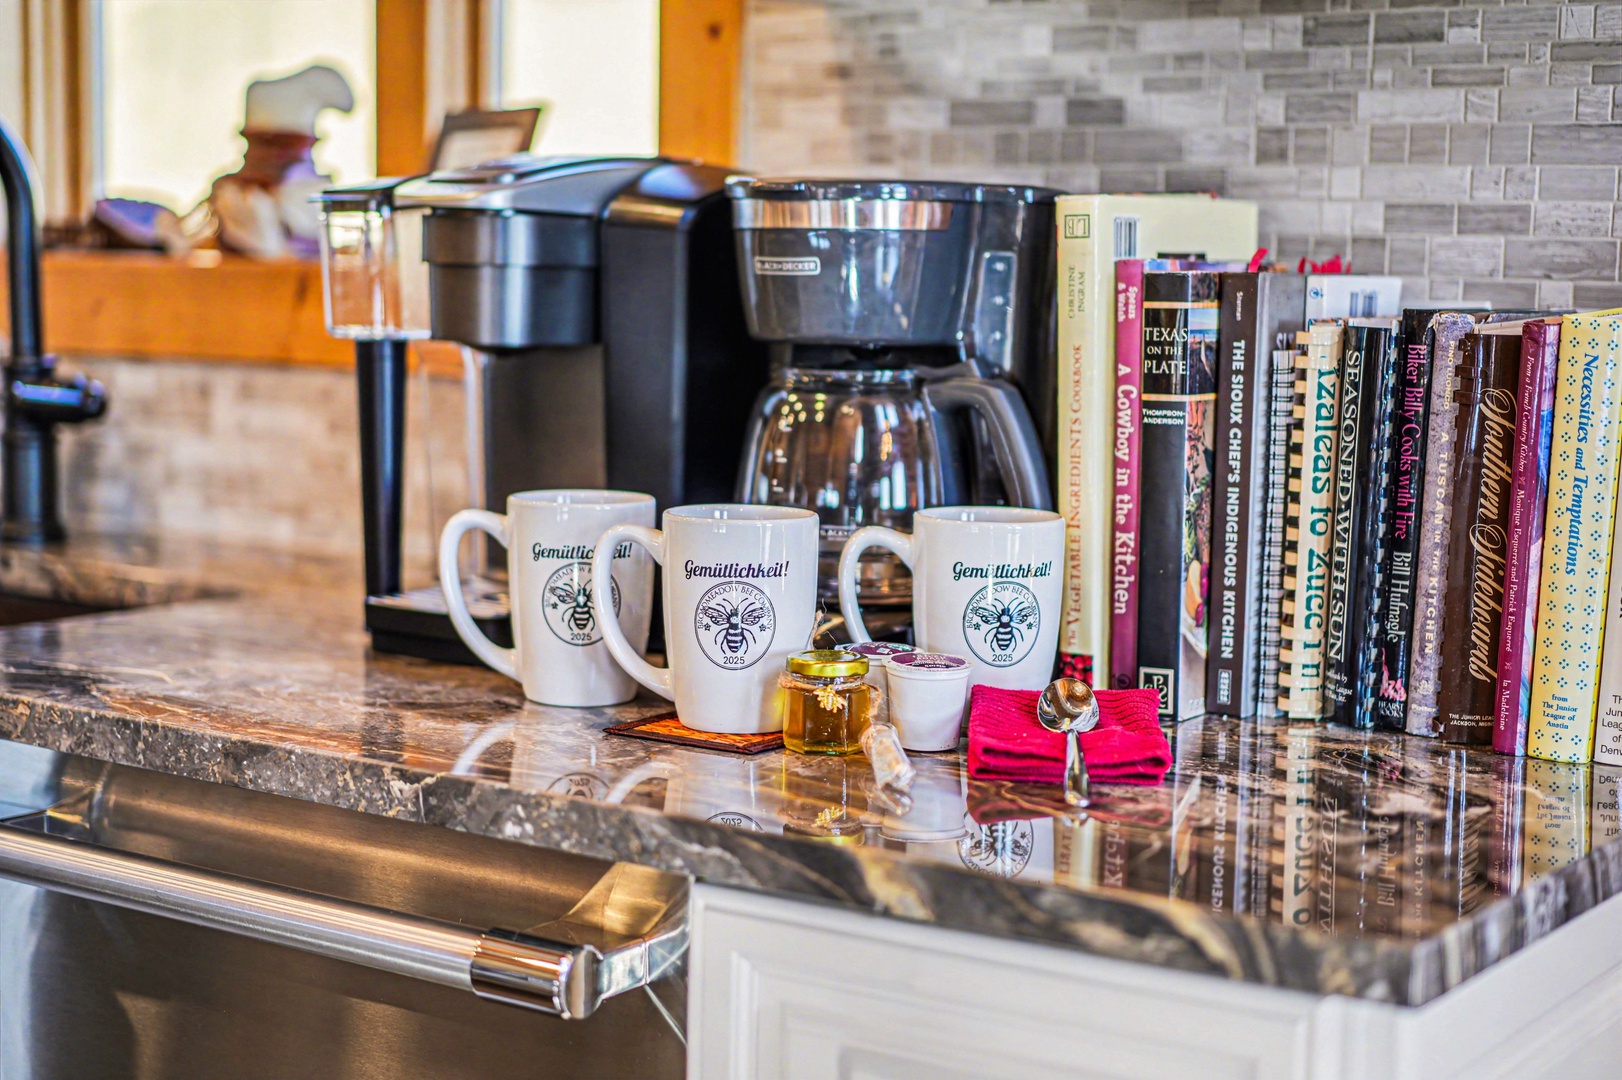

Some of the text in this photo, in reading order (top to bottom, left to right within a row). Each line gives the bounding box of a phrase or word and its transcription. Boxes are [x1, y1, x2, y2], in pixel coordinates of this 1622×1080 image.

[1068, 264, 1076, 319] CHRISTINE
[1078, 271, 1086, 313] INGRAM
[1144, 327, 1188, 341] TEXAS
[1147, 345, 1183, 355] ON THE
[1144, 360, 1187, 375] PLATE
[1232, 339, 1246, 371] THE
[1447, 340, 1456, 365] PINO
[1526, 355, 1535, 378] From
[1070, 344, 1082, 413] COOKBOOK
[1142, 408, 1187, 417] THOMPSON-
[1229, 374, 1244, 425] SIOUX
[1523, 386, 1534, 410] French
[1142, 417, 1184, 426] ANDERSON
[1521, 410, 1532, 444] Country
[1227, 429, 1243, 484] CHEF'S
[1395, 344, 1428, 540] Biker Billy Cooks with Fire
[1067, 417, 1082, 531] INGREDIENTS
[1518, 444, 1529, 474] Kitchen
[1564, 352, 1600, 577] Necessities and Temptations
[1113, 363, 1138, 614] A Cowboy in the Kitchen
[1309, 505, 1332, 537] to
[1513, 489, 1526, 525] Monique
[1223, 486, 1240, 588] INDIGENOUS
[1424, 432, 1450, 654] A TUSCAN IN THE KITCHEN
[1468, 388, 1518, 683] Southern Sideboards
[1511, 527, 1523, 566] Esquerré
[684, 559, 790, 580] Gemütlichkeit!
[952, 560, 1053, 581] Gemütlichkeit!
[1066, 535, 1082, 628] VEGETABLE
[1510, 566, 1519, 582] and
[740, 585, 755, 597] BEE
[753, 592, 773, 632] COMPANY
[1011, 585, 1024, 596] BEE
[1023, 592, 1038, 629] COMPANY
[1384, 551, 1412, 643] Bill Hufnagle
[1508, 583, 1519, 613] Patrick
[570, 632, 593, 641] 2025
[1219, 591, 1236, 660] KITCHEN
[1505, 615, 1516, 652] Esquerré
[723, 655, 746, 665] 2025
[992, 653, 1014, 663] 2025
[1502, 679, 1512, 688] la
[1551, 693, 1569, 703] from
[1499, 688, 1511, 731] Madeleine
[1542, 701, 1578, 713] The Junior
[1542, 710, 1576, 722] League of
[1546, 720, 1569, 730] Austin
